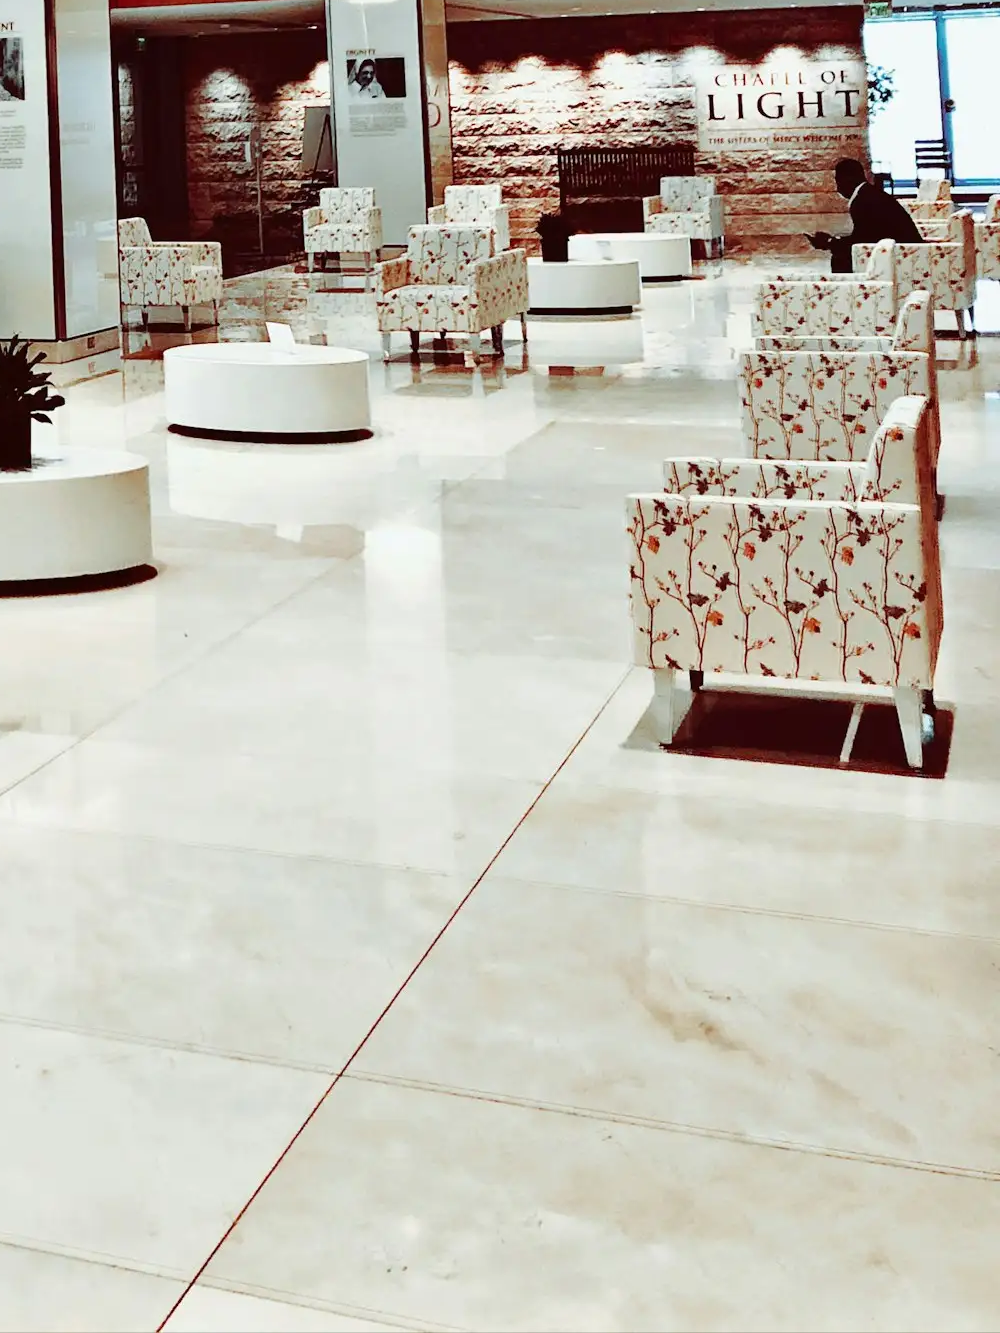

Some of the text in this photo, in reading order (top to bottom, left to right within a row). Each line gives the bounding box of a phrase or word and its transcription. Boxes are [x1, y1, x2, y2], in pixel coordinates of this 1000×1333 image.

[820, 70, 849, 85] OF
[707, 89, 860, 121] LIGHT
[708, 137, 725, 145] THE
